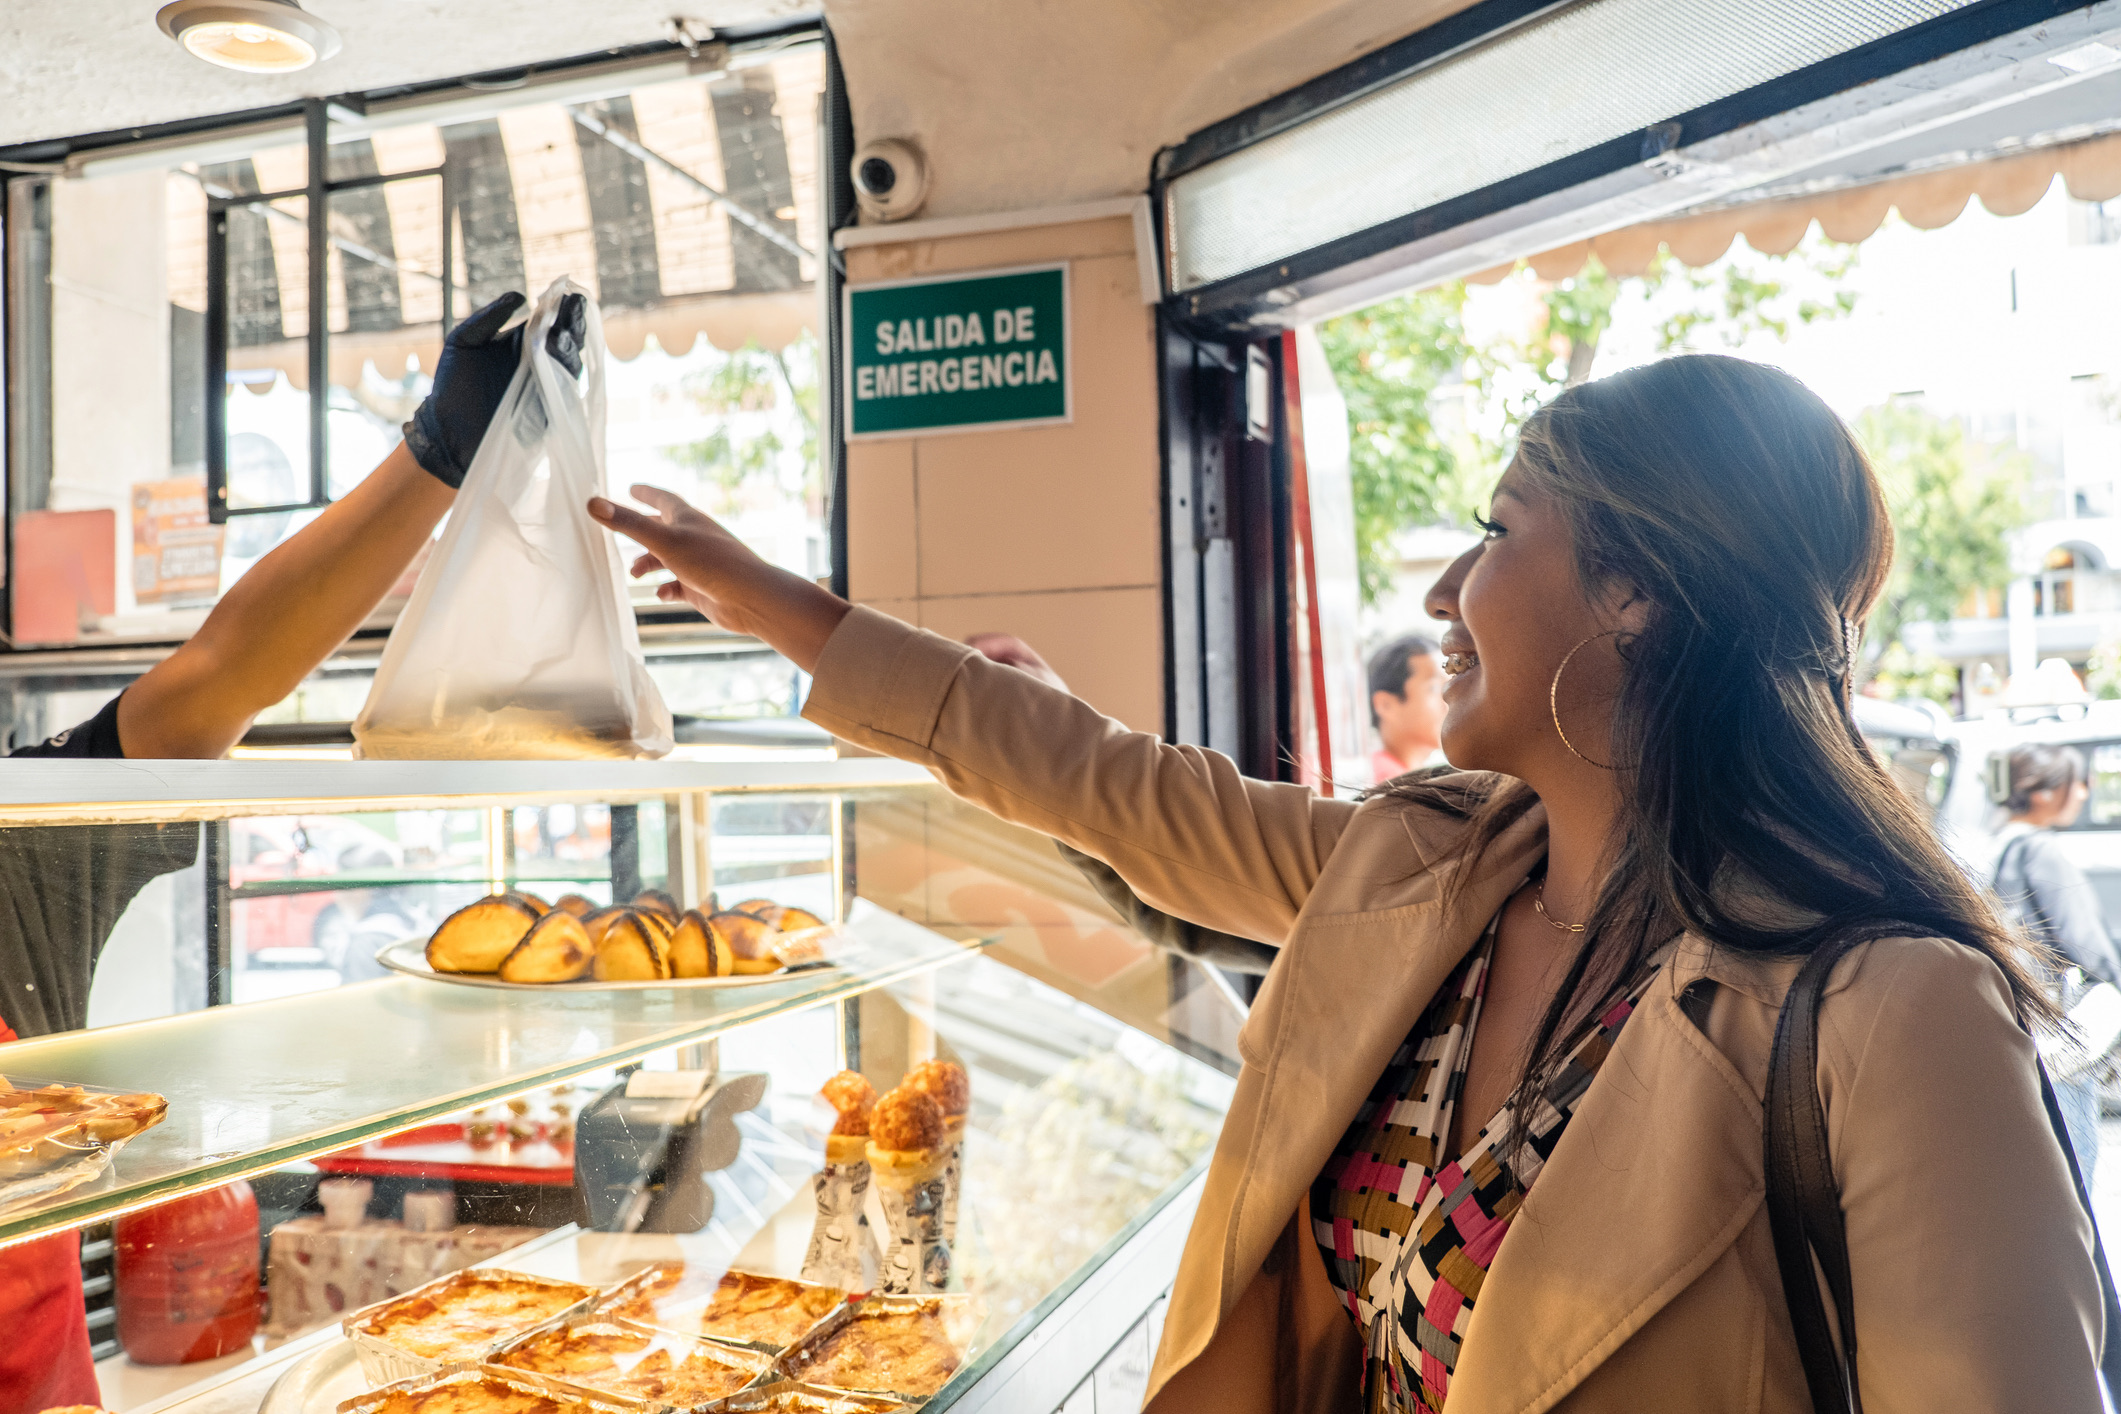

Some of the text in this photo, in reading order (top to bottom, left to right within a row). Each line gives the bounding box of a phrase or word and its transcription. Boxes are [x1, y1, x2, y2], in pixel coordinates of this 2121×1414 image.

[876, 306, 1034, 355] SALIDA DE
[856, 349, 1058, 400] EMERGENCIA
